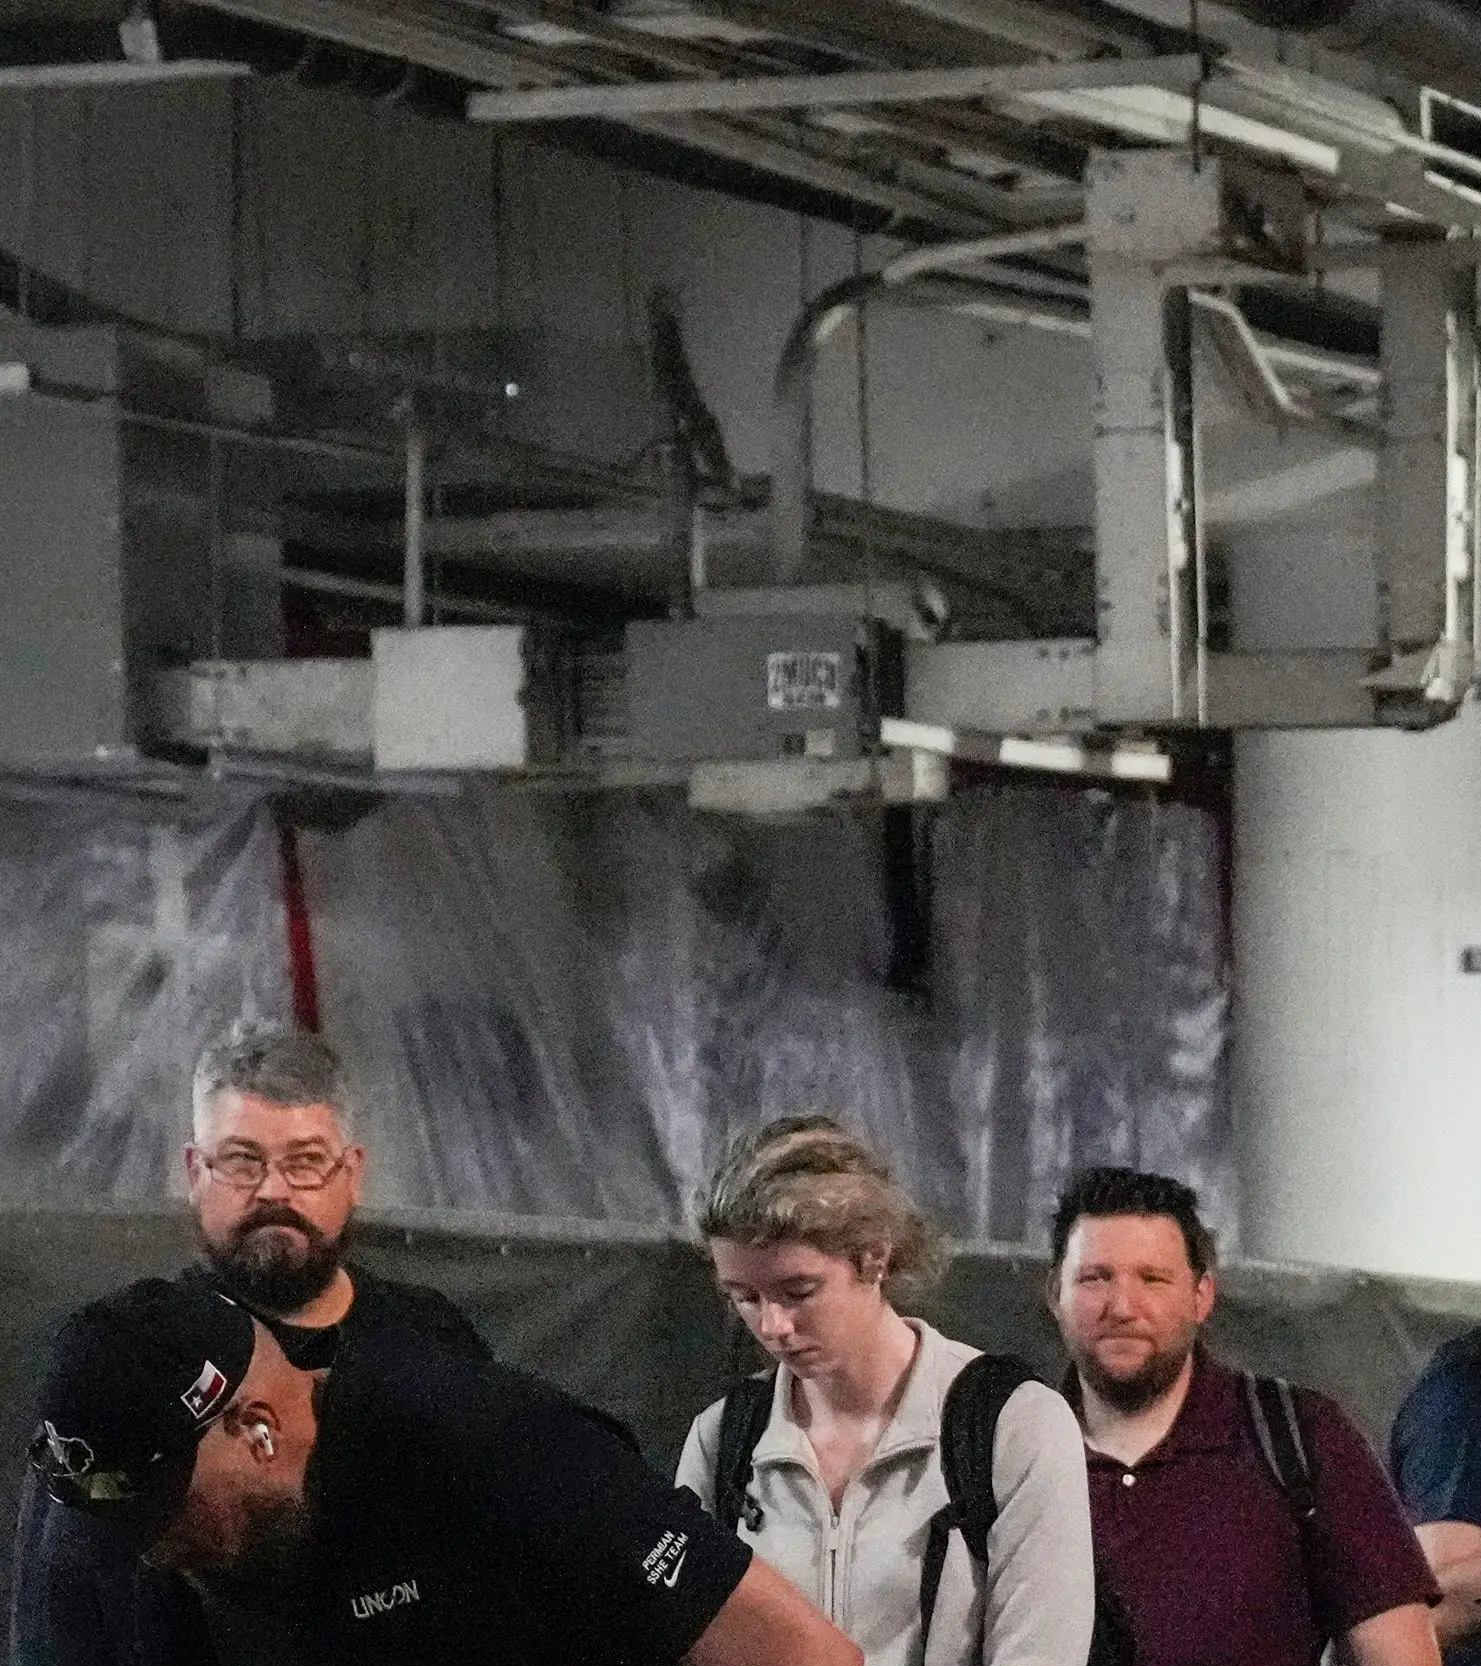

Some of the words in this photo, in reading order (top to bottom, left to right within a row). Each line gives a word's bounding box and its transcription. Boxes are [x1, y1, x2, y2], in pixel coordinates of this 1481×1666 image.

[642, 1530, 675, 1571] PERMIAN
[647, 1559, 669, 1585] SSHE
[664, 1532, 689, 1560] TEAM
